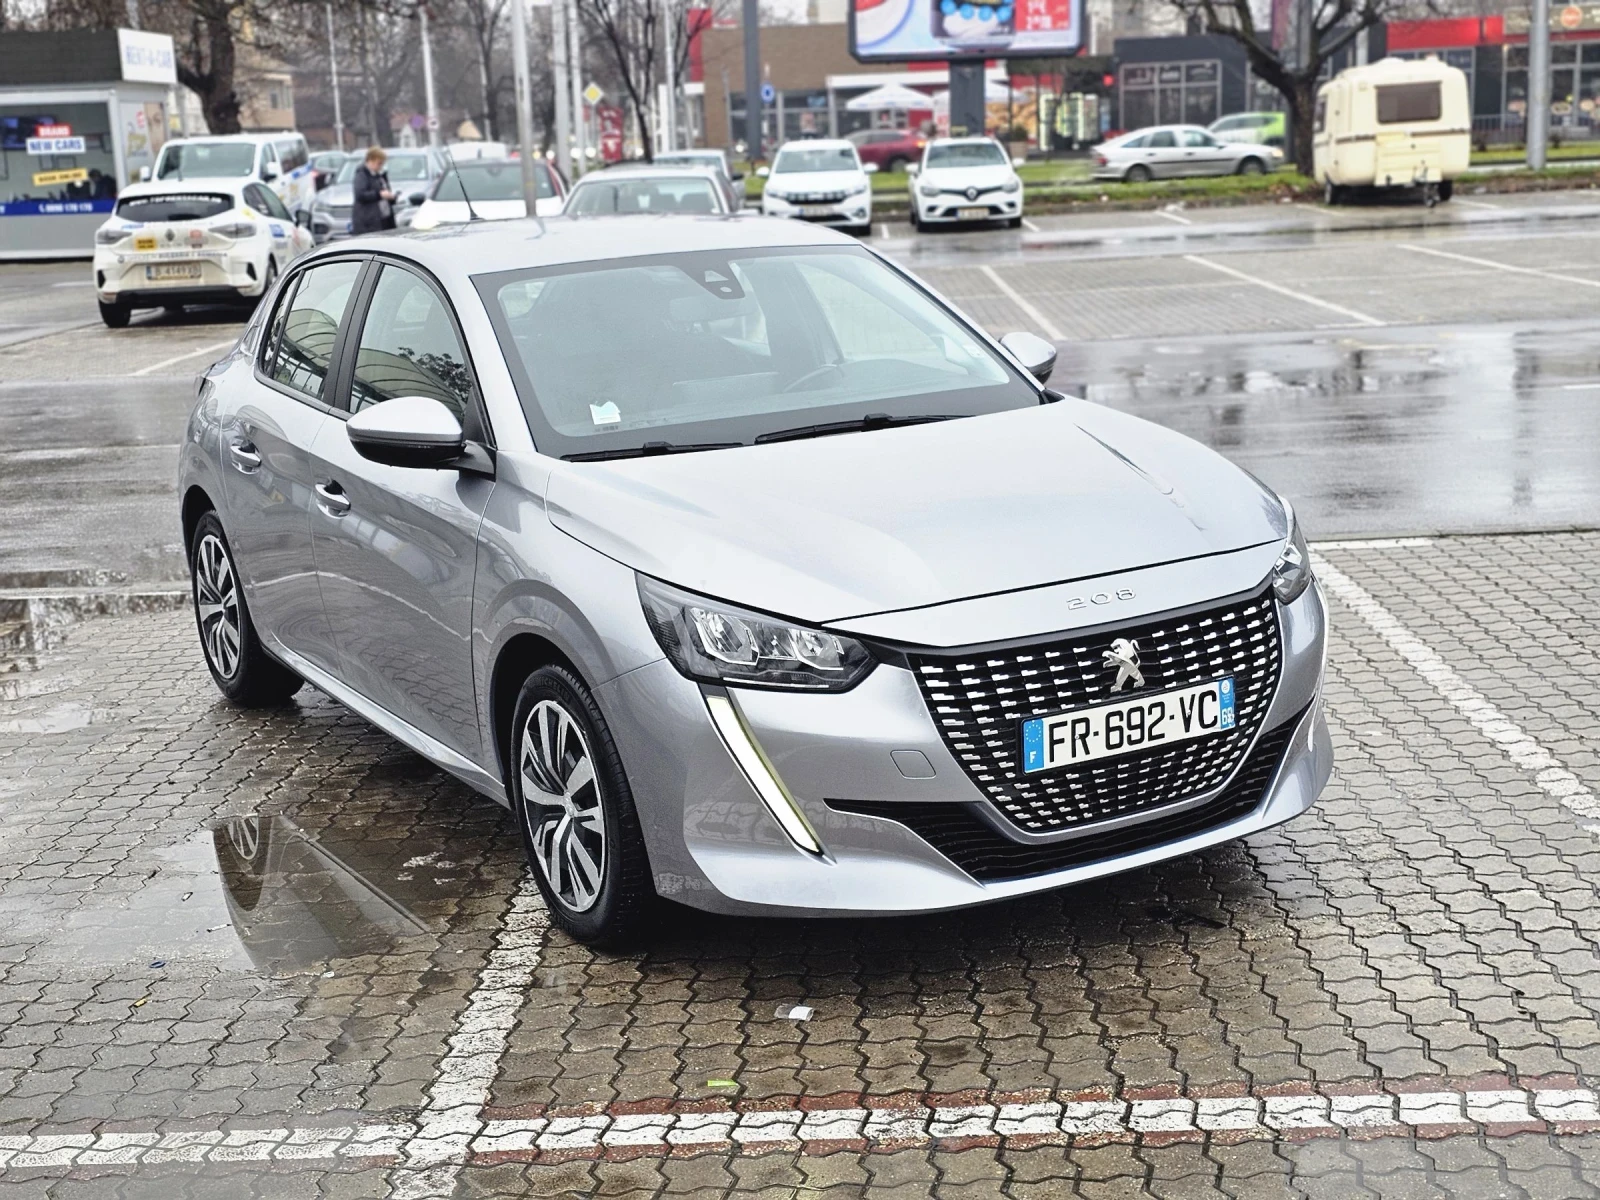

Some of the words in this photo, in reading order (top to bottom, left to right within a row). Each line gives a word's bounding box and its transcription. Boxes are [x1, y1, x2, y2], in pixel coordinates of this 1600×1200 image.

[29, 141, 52, 151] NEW
[55, 140, 82, 150] CARS
[1066, 588, 1137, 610] 208
[1029, 751, 1037, 763] F
[1048, 690, 1218, 763] FR-692-VC
